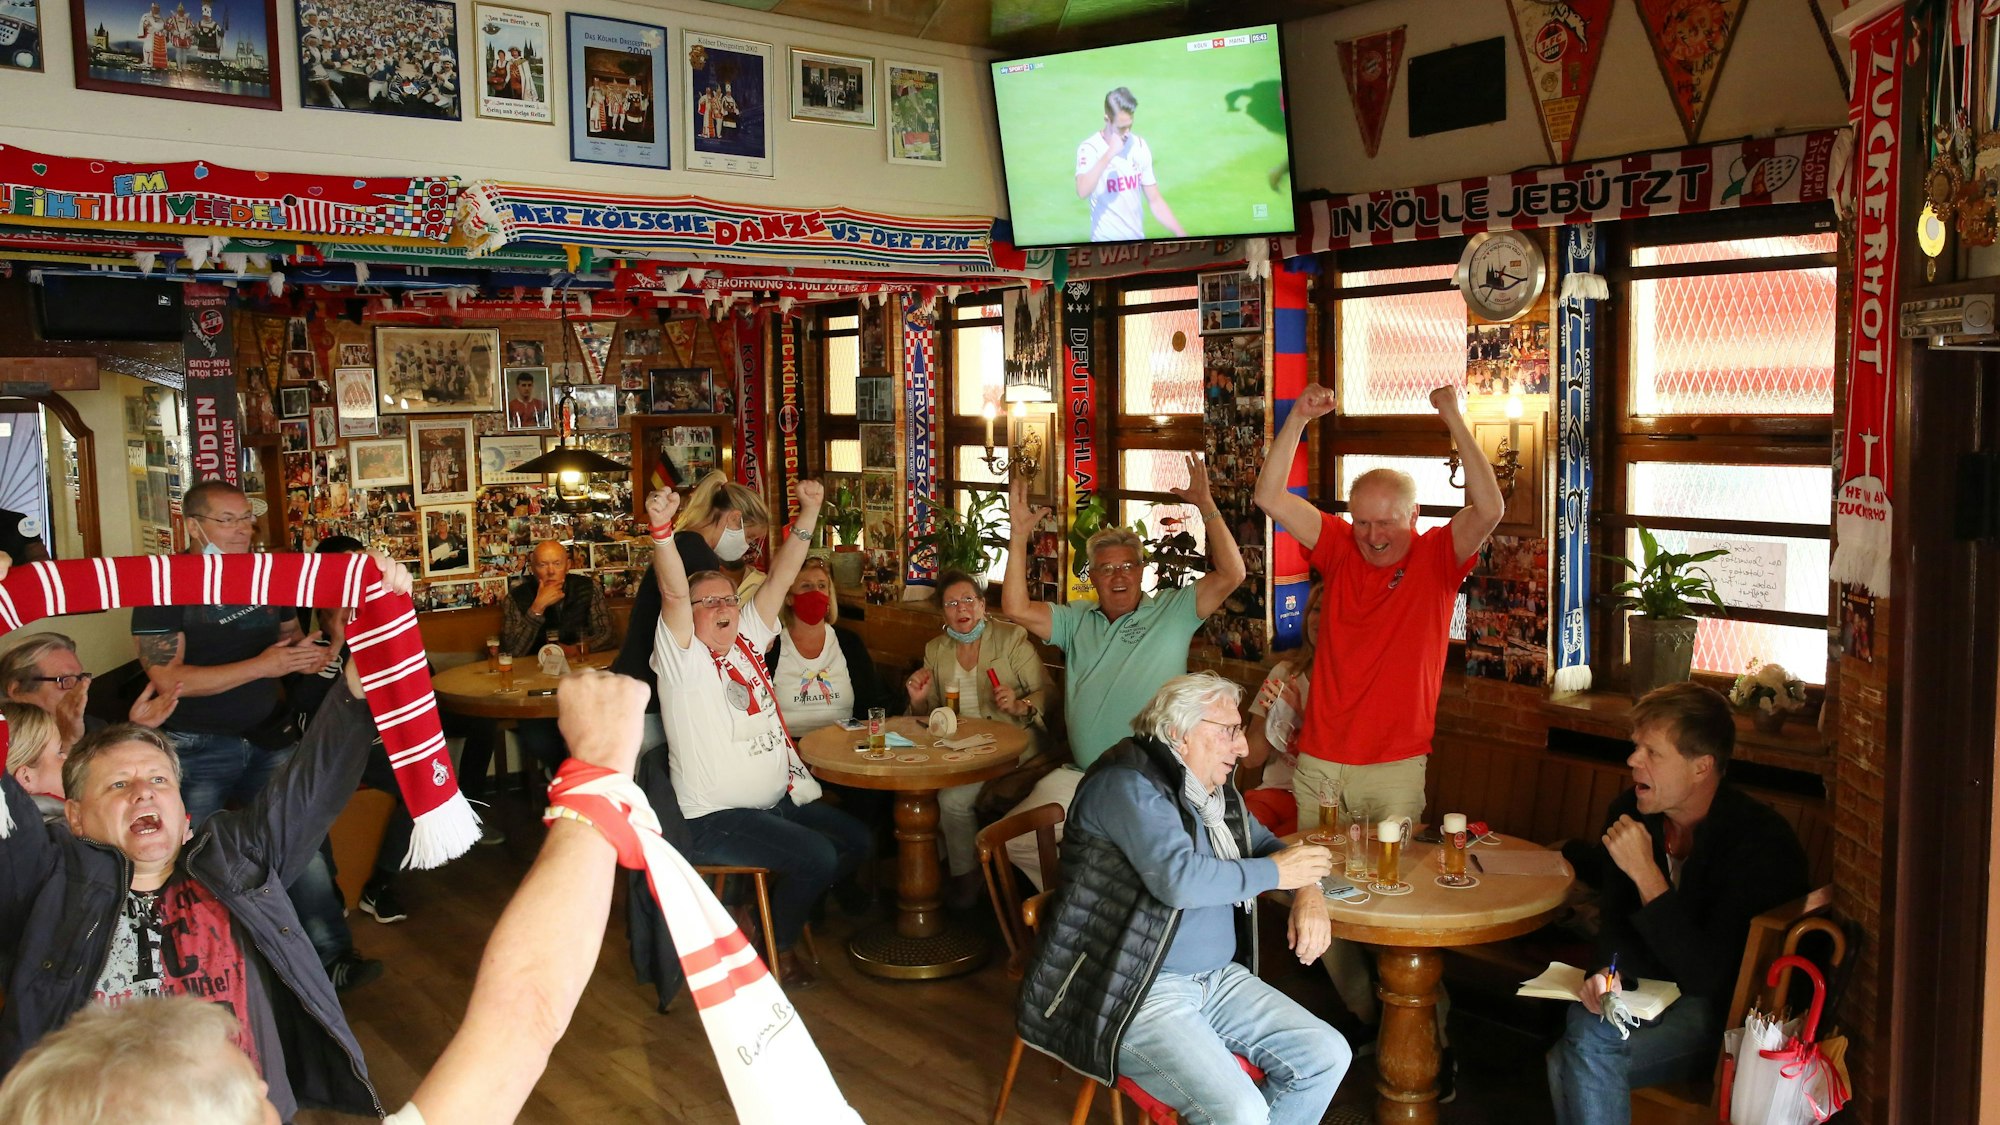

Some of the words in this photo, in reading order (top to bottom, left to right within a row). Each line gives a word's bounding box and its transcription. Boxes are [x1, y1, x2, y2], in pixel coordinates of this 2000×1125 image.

[584, 32, 596, 40] DAS
[698, 36, 716, 46] Kölner
[745, 44, 758, 53] 2002
[628, 46, 652, 56] 2000
[1804, 138, 1820, 184] KÖLLE
[1814, 136, 1832, 196] JEBÜTZT
[113, 171, 168, 197] EM
[1106, 173, 1142, 194] REWE
[1496, 162, 1710, 218] JEBÜTZT
[1802, 186, 1812, 198] IN
[166, 195, 287, 226] VEEDEL
[424, 180, 448, 240] 2020
[1858, 36, 1899, 375] ZUCKERHOT
[510, 203, 568, 225] MER
[581, 206, 711, 234] KÖLSCHE
[714, 210, 827, 246] DANZE
[830, 222, 861, 244] US
[871, 228, 913, 250] DER
[921, 234, 970, 251] REIN
[188, 358, 231, 368] FAN-CLUB
[188, 369, 211, 380] KÖLN
[914, 372, 927, 505] HRVATSKA
[794, 692, 840, 704] PARADISE
